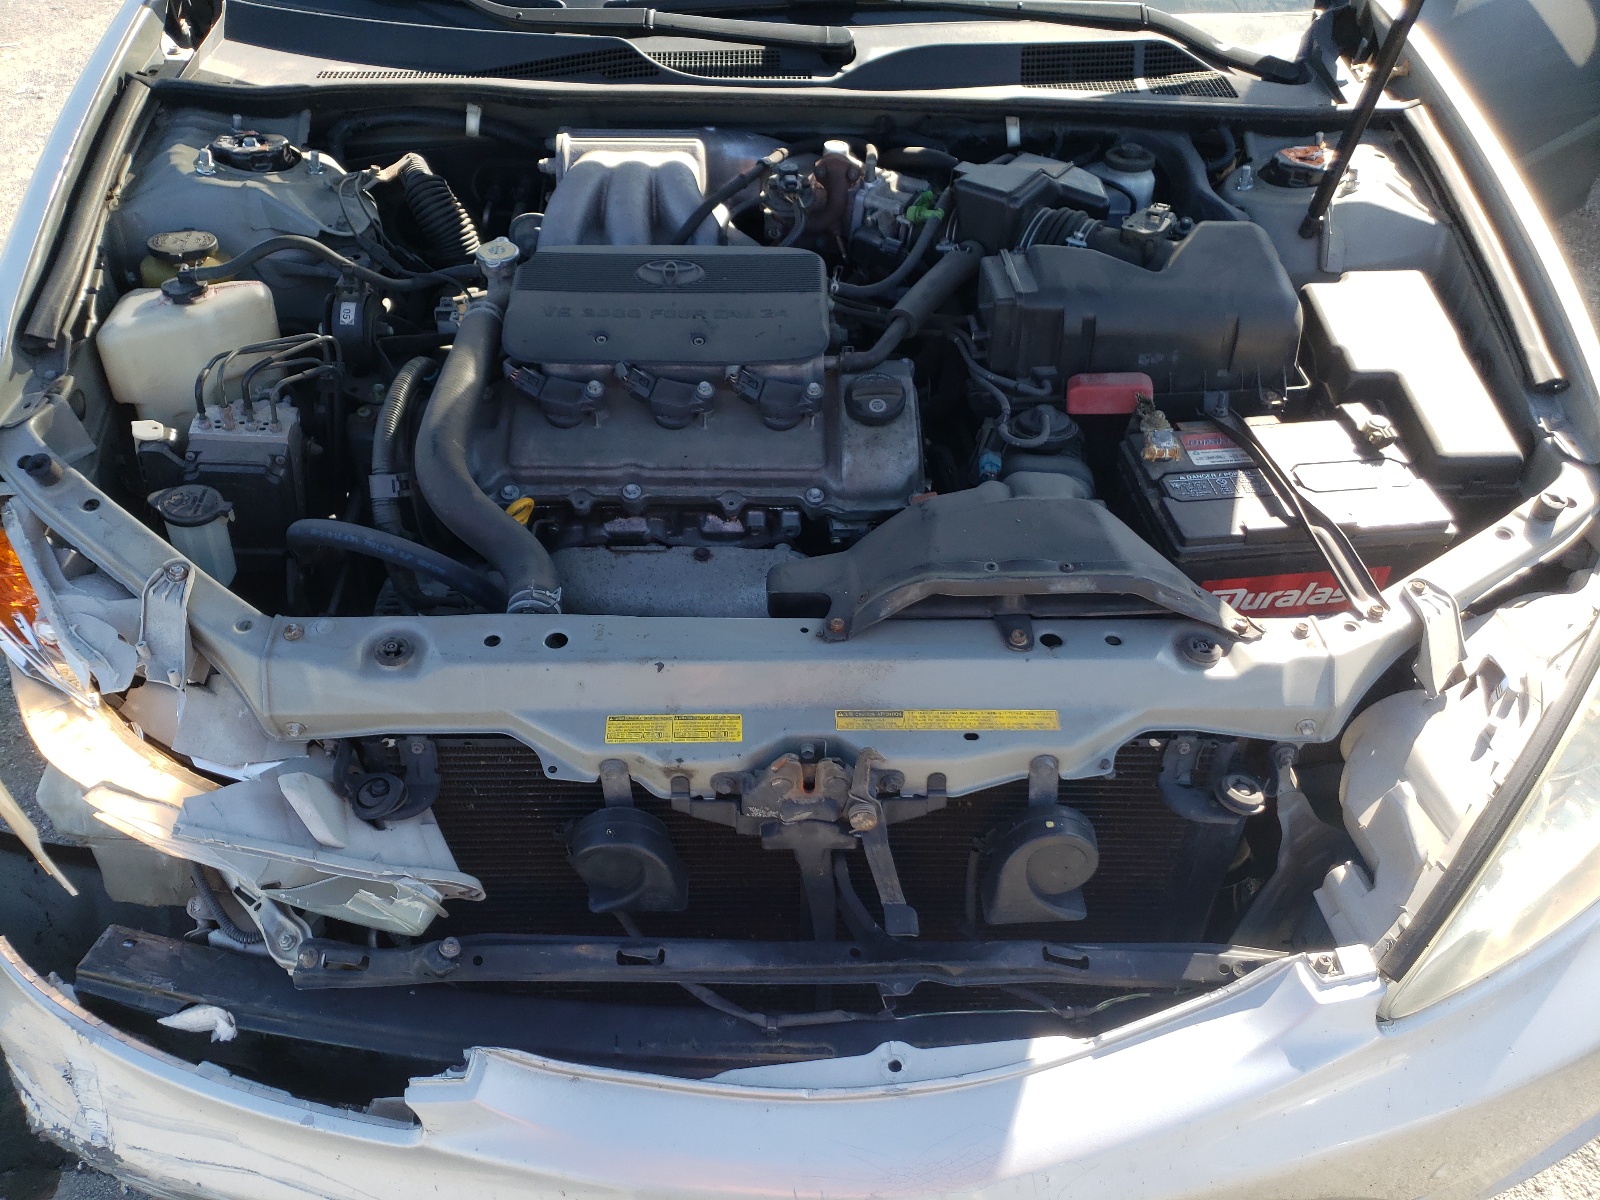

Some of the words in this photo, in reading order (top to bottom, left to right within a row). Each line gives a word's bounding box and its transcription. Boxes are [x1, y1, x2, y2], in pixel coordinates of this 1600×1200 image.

[342, 308, 351, 320] 05
[650, 307, 707, 320] FOUR
[1211, 582, 1349, 611] Duralas
